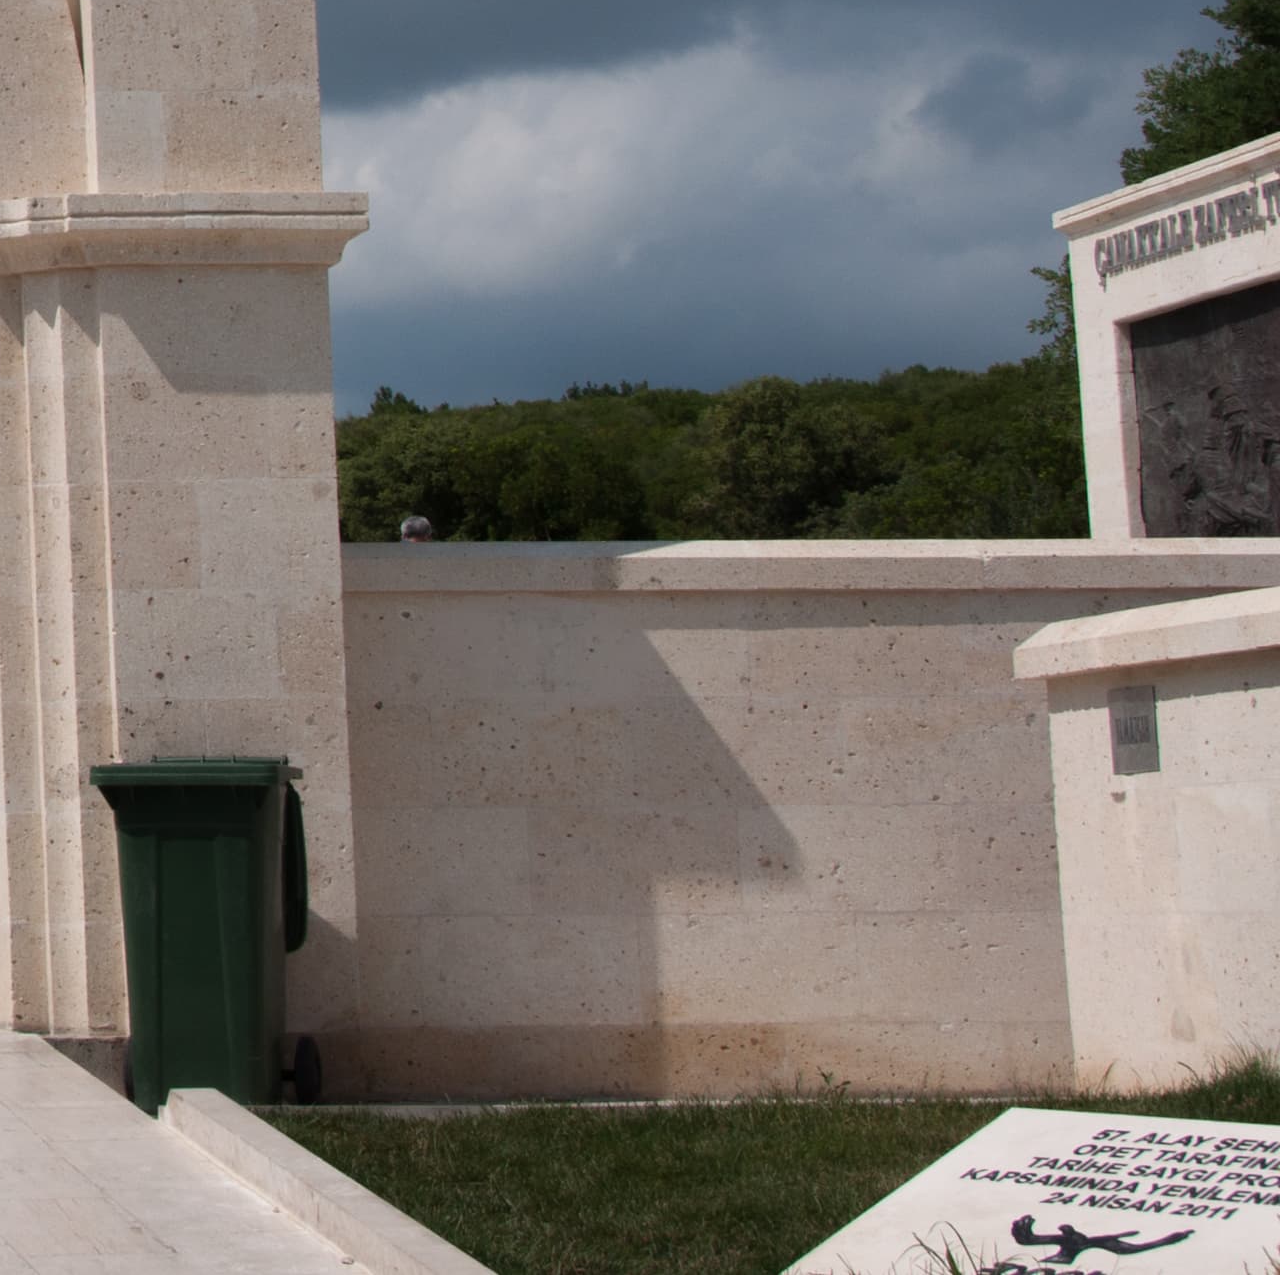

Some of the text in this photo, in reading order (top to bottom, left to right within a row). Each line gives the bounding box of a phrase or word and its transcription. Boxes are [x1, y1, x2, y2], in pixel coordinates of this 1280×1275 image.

[1092, 1128, 1130, 1142] 57.
[1133, 1132, 1216, 1147] ALAY
[1073, 1144, 1152, 1160] OPET
[960, 1167, 1140, 1193] KAPSAMINDA
[1027, 1156, 1128, 1175] TARİHE
[1127, 1164, 1217, 1182] SAYGI
[1040, 1191, 1238, 1220] 24 NİSAN 2011
